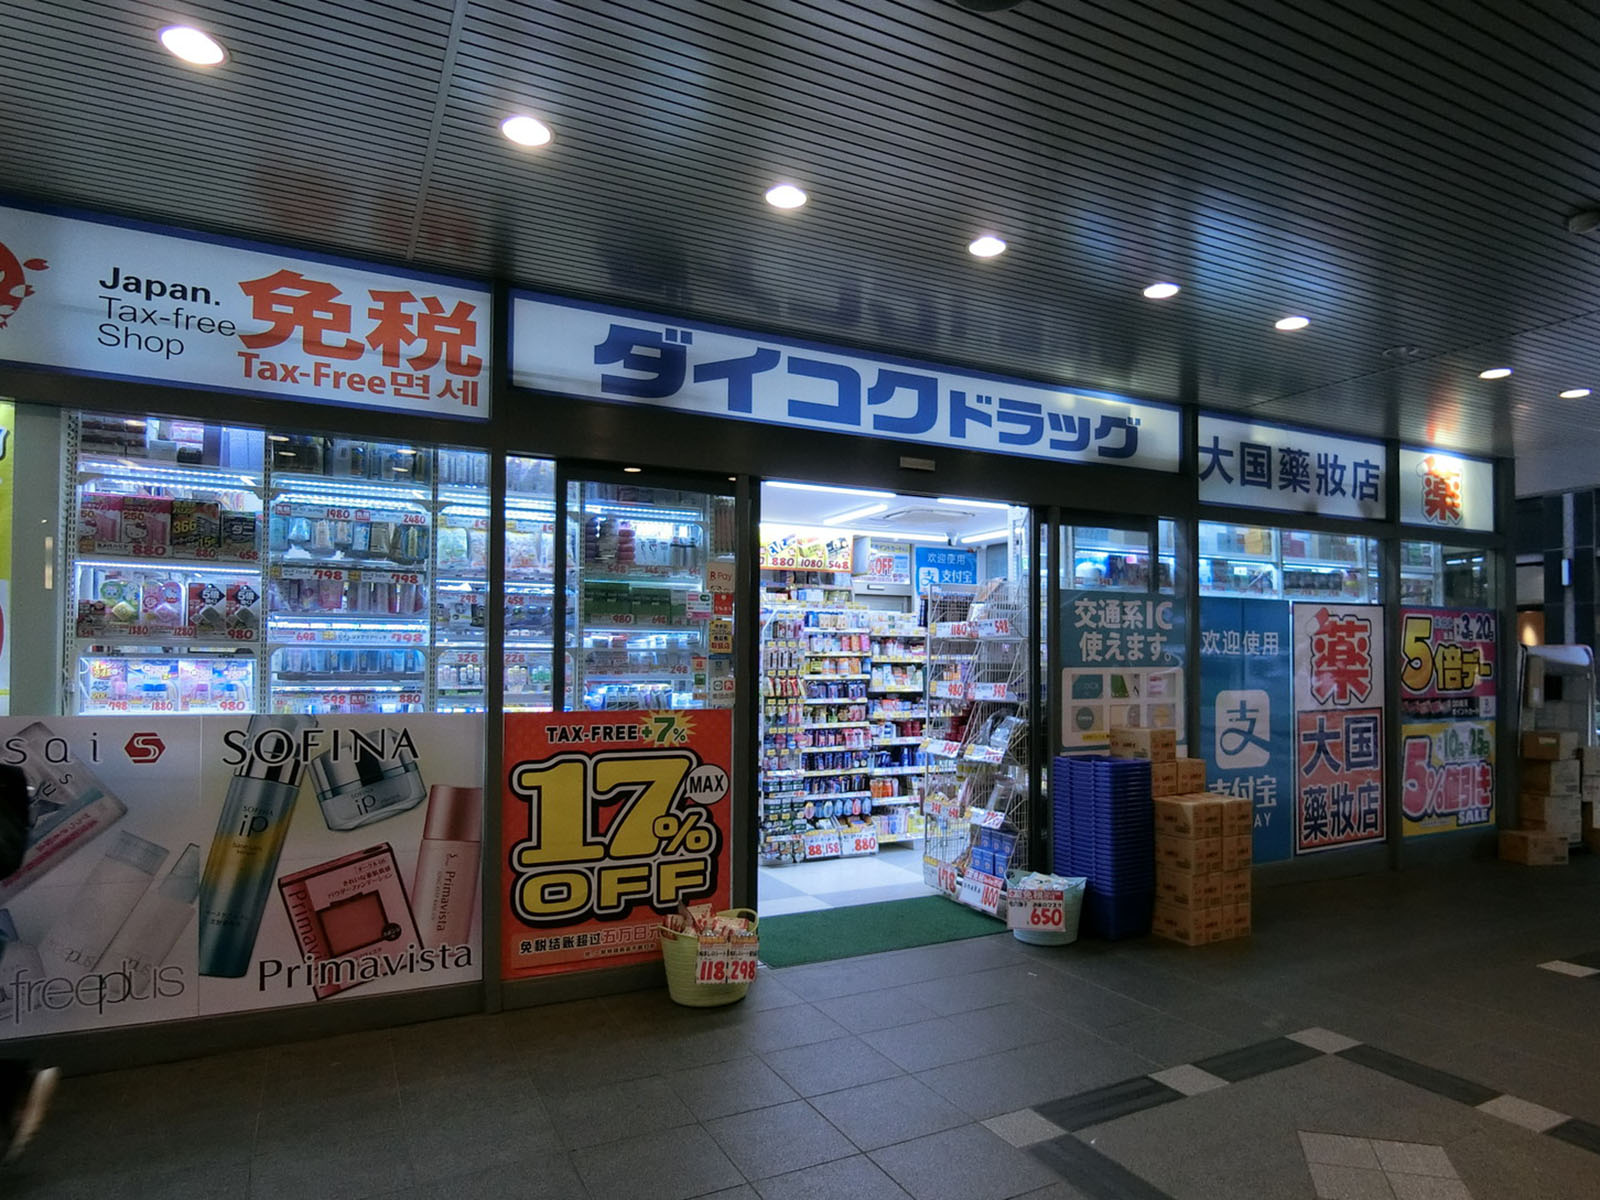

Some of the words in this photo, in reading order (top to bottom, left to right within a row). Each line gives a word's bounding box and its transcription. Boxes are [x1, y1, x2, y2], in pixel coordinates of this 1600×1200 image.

[99, 267, 221, 306] Japan.
[98, 295, 236, 337] Tax-free
[238, 268, 483, 378] 免税
[97, 322, 185, 360] Shop
[237, 352, 387, 394] Tax-Free
[390, 371, 479, 407] 면세
[594, 322, 1141, 460] ダイコクドラッグ
[326, 508, 350, 519] 1980
[403, 514, 426, 524] 2480
[771, 557, 795, 567] 880
[800, 558, 823, 568] 1080
[828, 561, 849, 569] 548
[313, 569, 344, 581] 798
[391, 573, 419, 584] 798
[941, 568, 973, 584] 支付宝
[1074, 597, 1173, 631] 交通系IC
[227, 629, 253, 640] 980
[1202, 630, 1280, 656] 欢迎使用
[1079, 631, 1171, 662] 使えます。
[1401, 616, 1492, 691] 5倍デー
[108, 701, 128, 711] 798
[219, 701, 246, 711] 980
[546, 725, 638, 743] TAX-FREE
[222, 728, 419, 765] SOFINA
[1302, 716, 1379, 777] 大国
[689, 774, 724, 794] MAX
[243, 805, 274, 817] SOFINA
[516, 755, 714, 868] 17%
[1457, 809, 1489, 825] SALE
[239, 814, 269, 838] ip
[808, 845, 822, 856] 88
[854, 837, 876, 852] 880
[521, 860, 706, 915] OFF
[436, 870, 456, 932] Primavista
[1030, 909, 1063, 926] 650
[258, 943, 474, 992] Primavista
[700, 960, 725, 981] 118
[730, 960, 756, 980] 298
[9, 960, 185, 1024] freeplus
